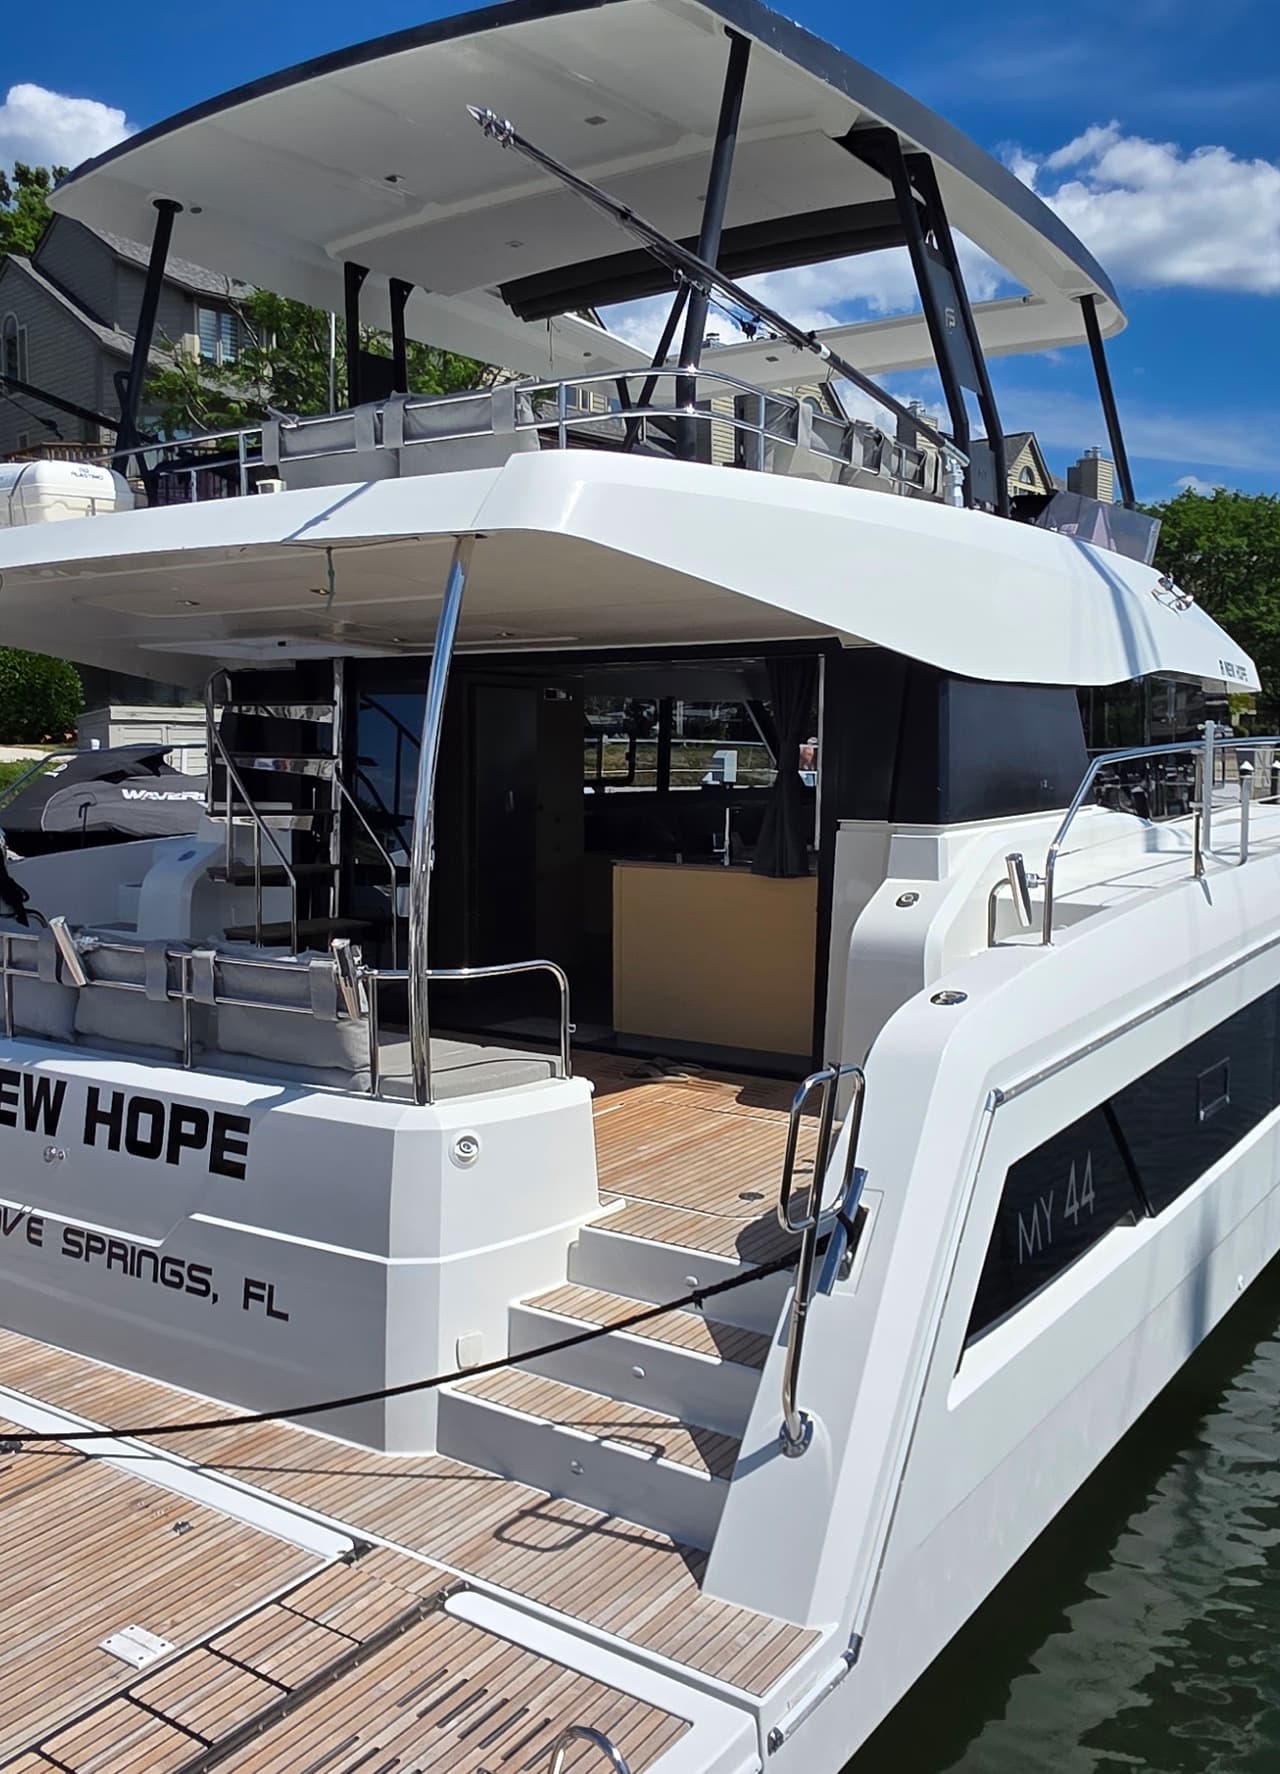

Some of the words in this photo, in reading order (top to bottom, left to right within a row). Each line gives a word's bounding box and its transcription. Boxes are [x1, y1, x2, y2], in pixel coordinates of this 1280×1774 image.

[83, 1086, 251, 1181] HOPE
[1019, 1190, 1054, 1264] MY
[1064, 1150, 1095, 1225] 44
[61, 1226, 218, 1305] SPRINGS,
[242, 1277, 289, 1322] FL
